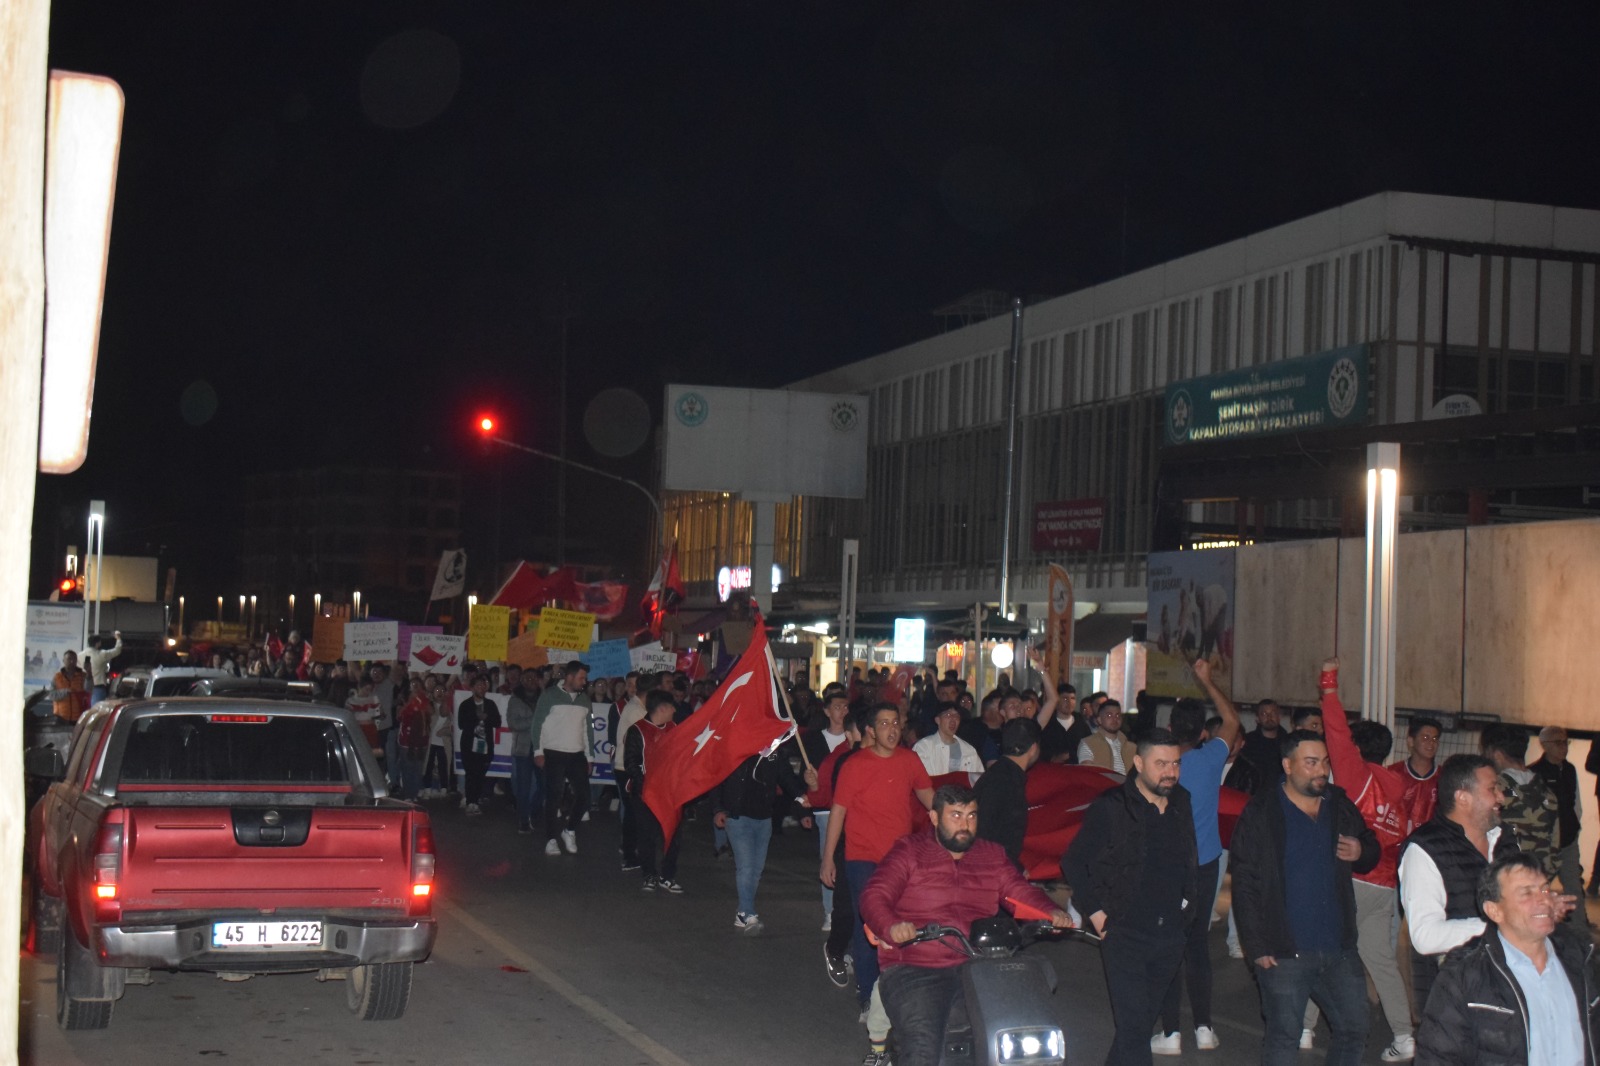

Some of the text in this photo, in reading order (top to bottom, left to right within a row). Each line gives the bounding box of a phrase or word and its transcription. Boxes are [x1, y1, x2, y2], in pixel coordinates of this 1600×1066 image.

[1218, 400, 1240, 423] ŞEHİT
[1189, 425, 1217, 441] KAPALI
[225, 924, 319, 942] 45 H 6222
